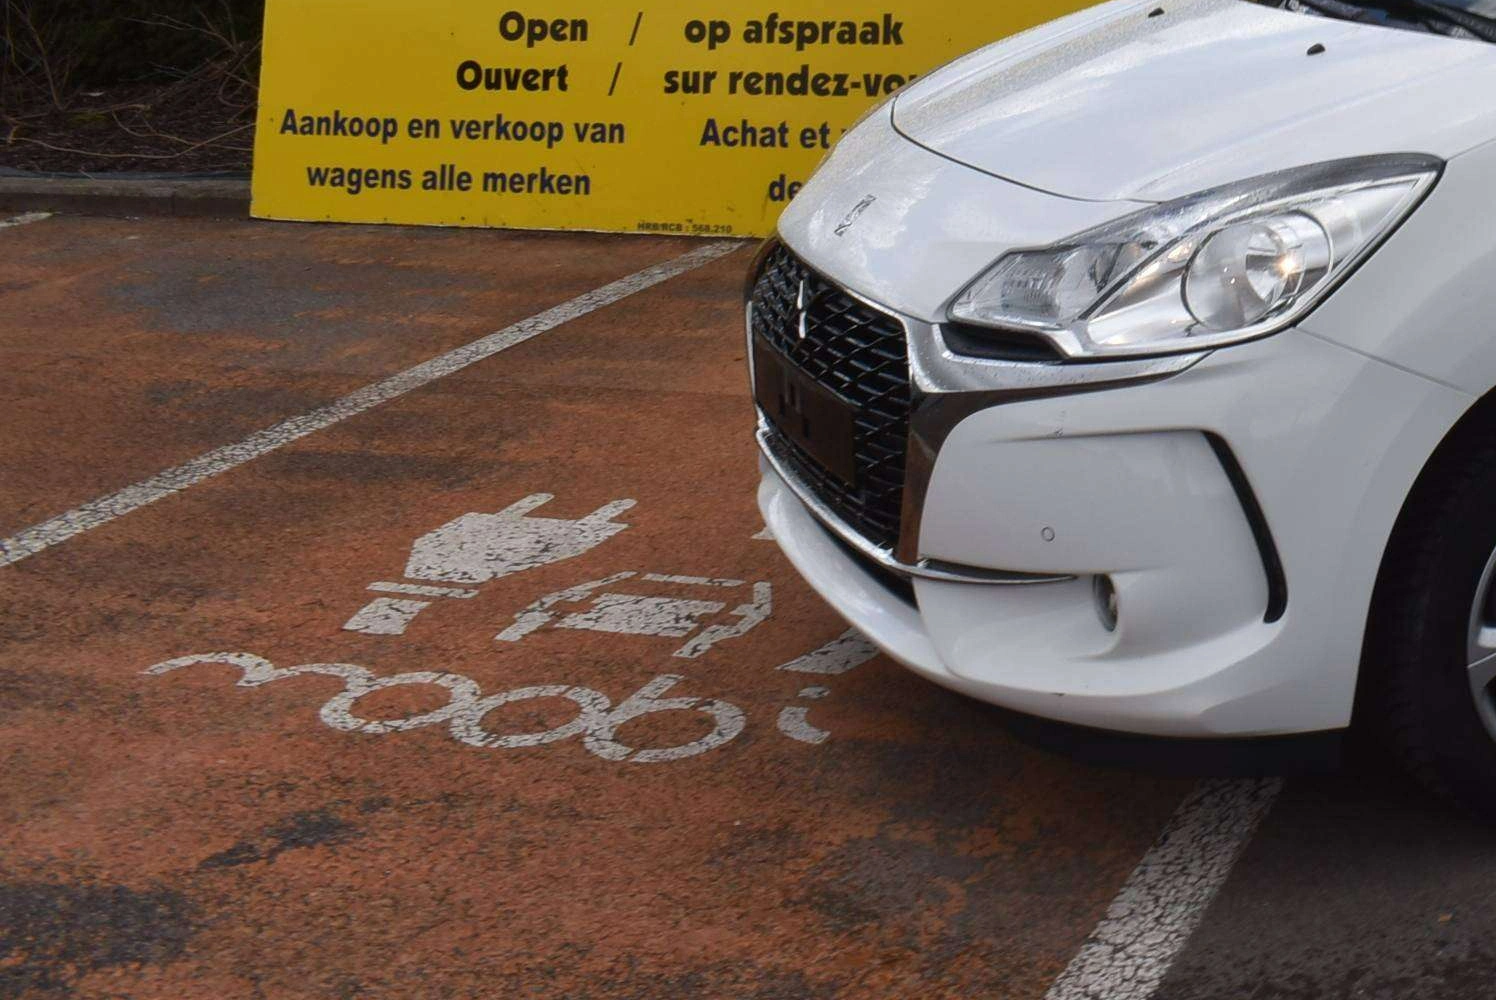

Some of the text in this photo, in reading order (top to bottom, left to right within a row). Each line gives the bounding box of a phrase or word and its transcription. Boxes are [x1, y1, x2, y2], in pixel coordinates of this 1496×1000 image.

[498, 11, 588, 48] Open
[684, 18, 731, 51] op
[742, 12, 904, 51] afspraak
[456, 59, 569, 93] Ouvert
[664, 71, 718, 95] sur
[728, 63, 918, 98] rendez-vo
[280, 108, 625, 150] Aankoop en verkoop van
[699, 117, 790, 149] Achat
[799, 121, 831, 150] et
[306, 163, 591, 196] wagens alle merken
